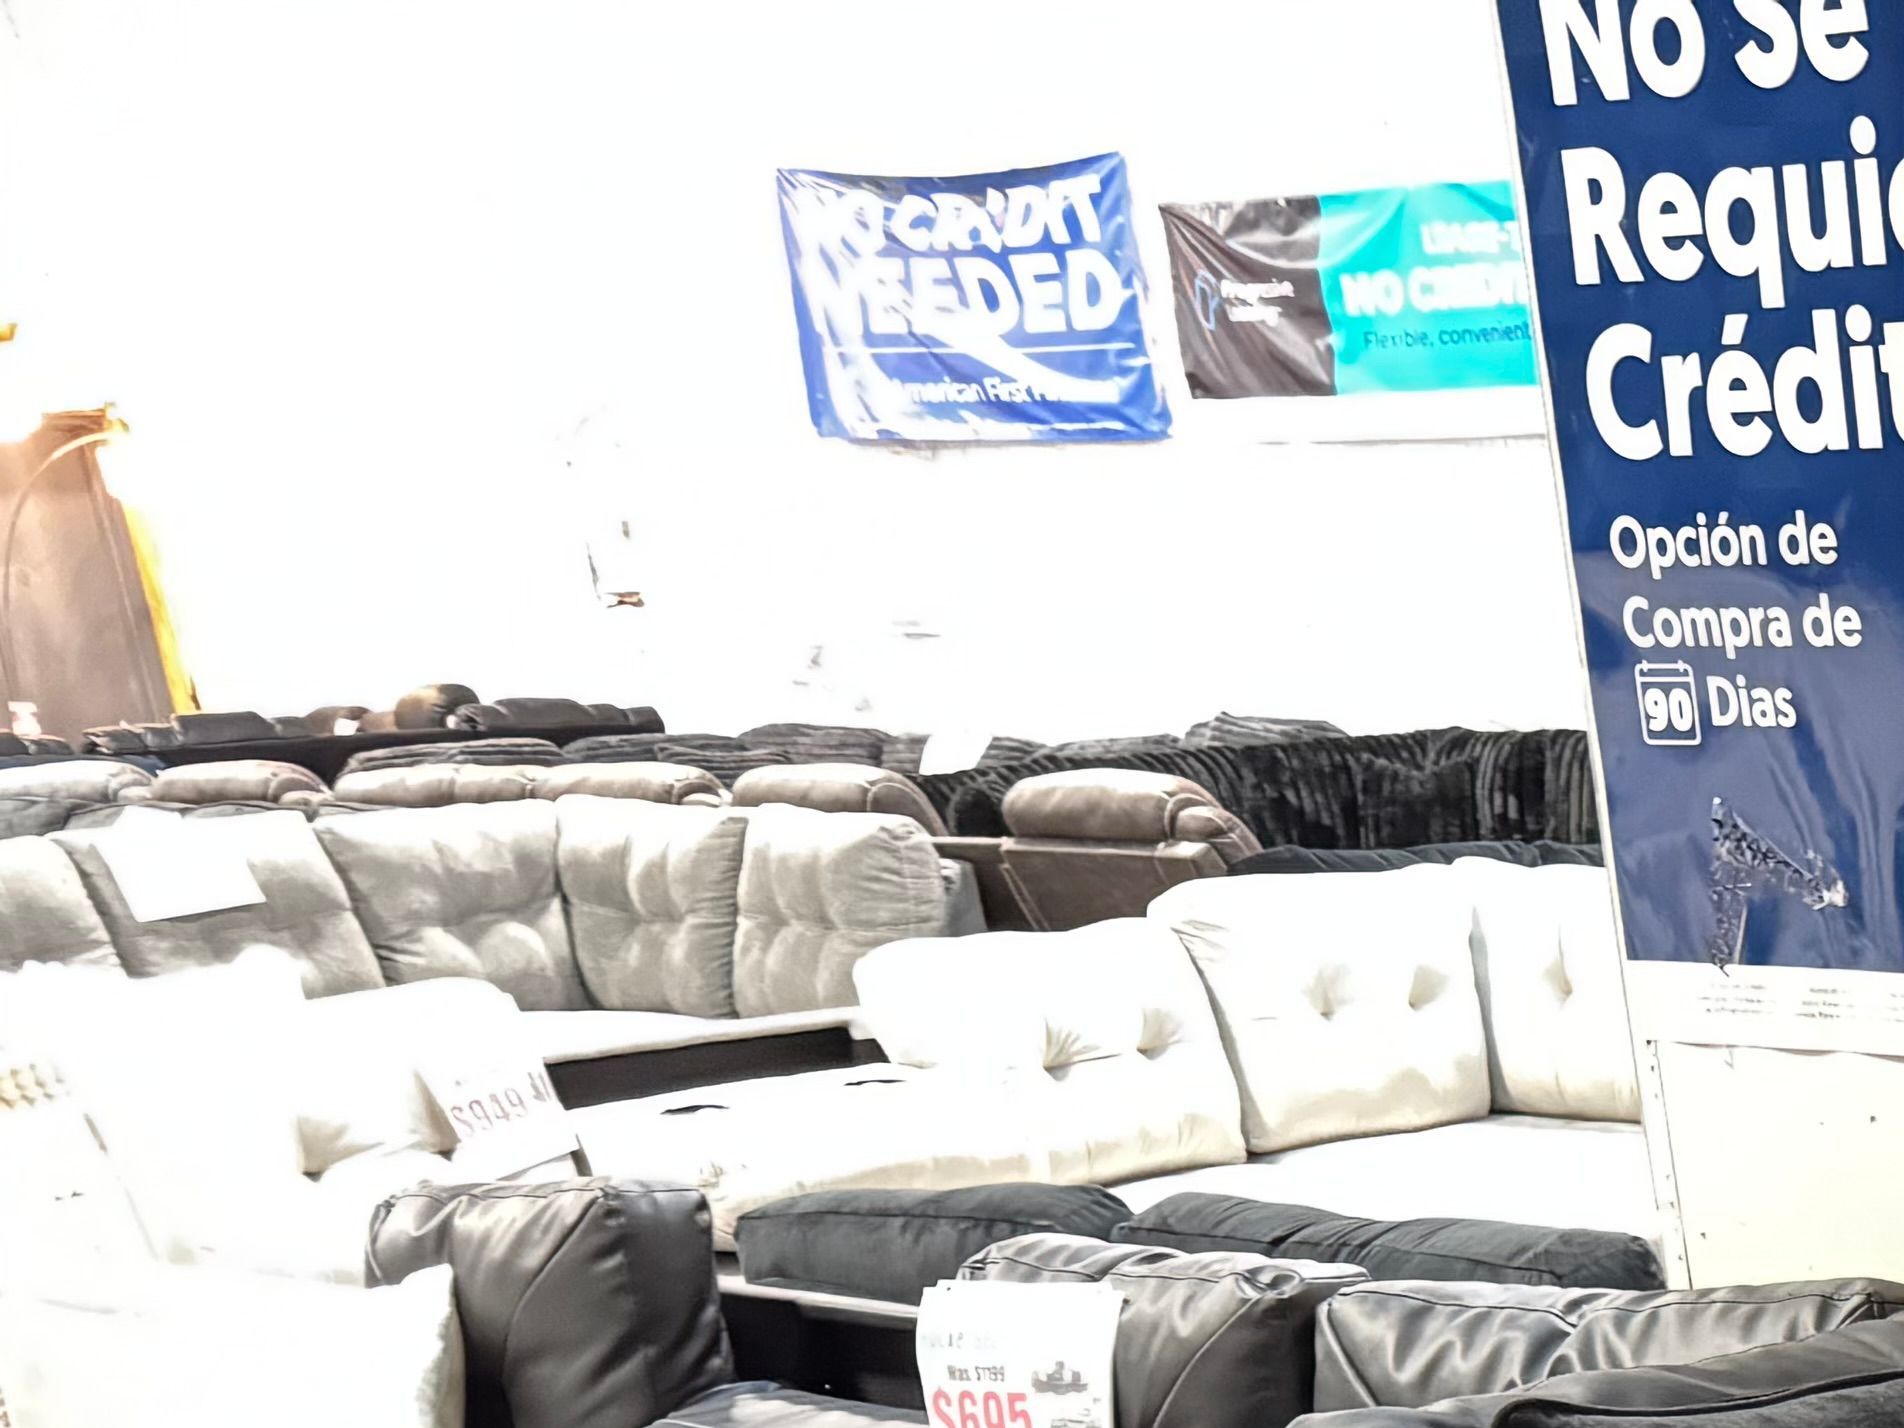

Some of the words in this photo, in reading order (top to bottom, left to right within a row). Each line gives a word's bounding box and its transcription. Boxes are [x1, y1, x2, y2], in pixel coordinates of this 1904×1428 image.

[1538, 0, 1705, 106] No
[1734, 0, 1869, 89] Se
[1608, 511, 1768, 580] Opción
[1779, 510, 1839, 566] de
[1623, 596, 1793, 659] Compra
[1802, 593, 1863, 648] de
[1644, 687, 1693, 732] 90
[1706, 674, 1797, 728] Dias
